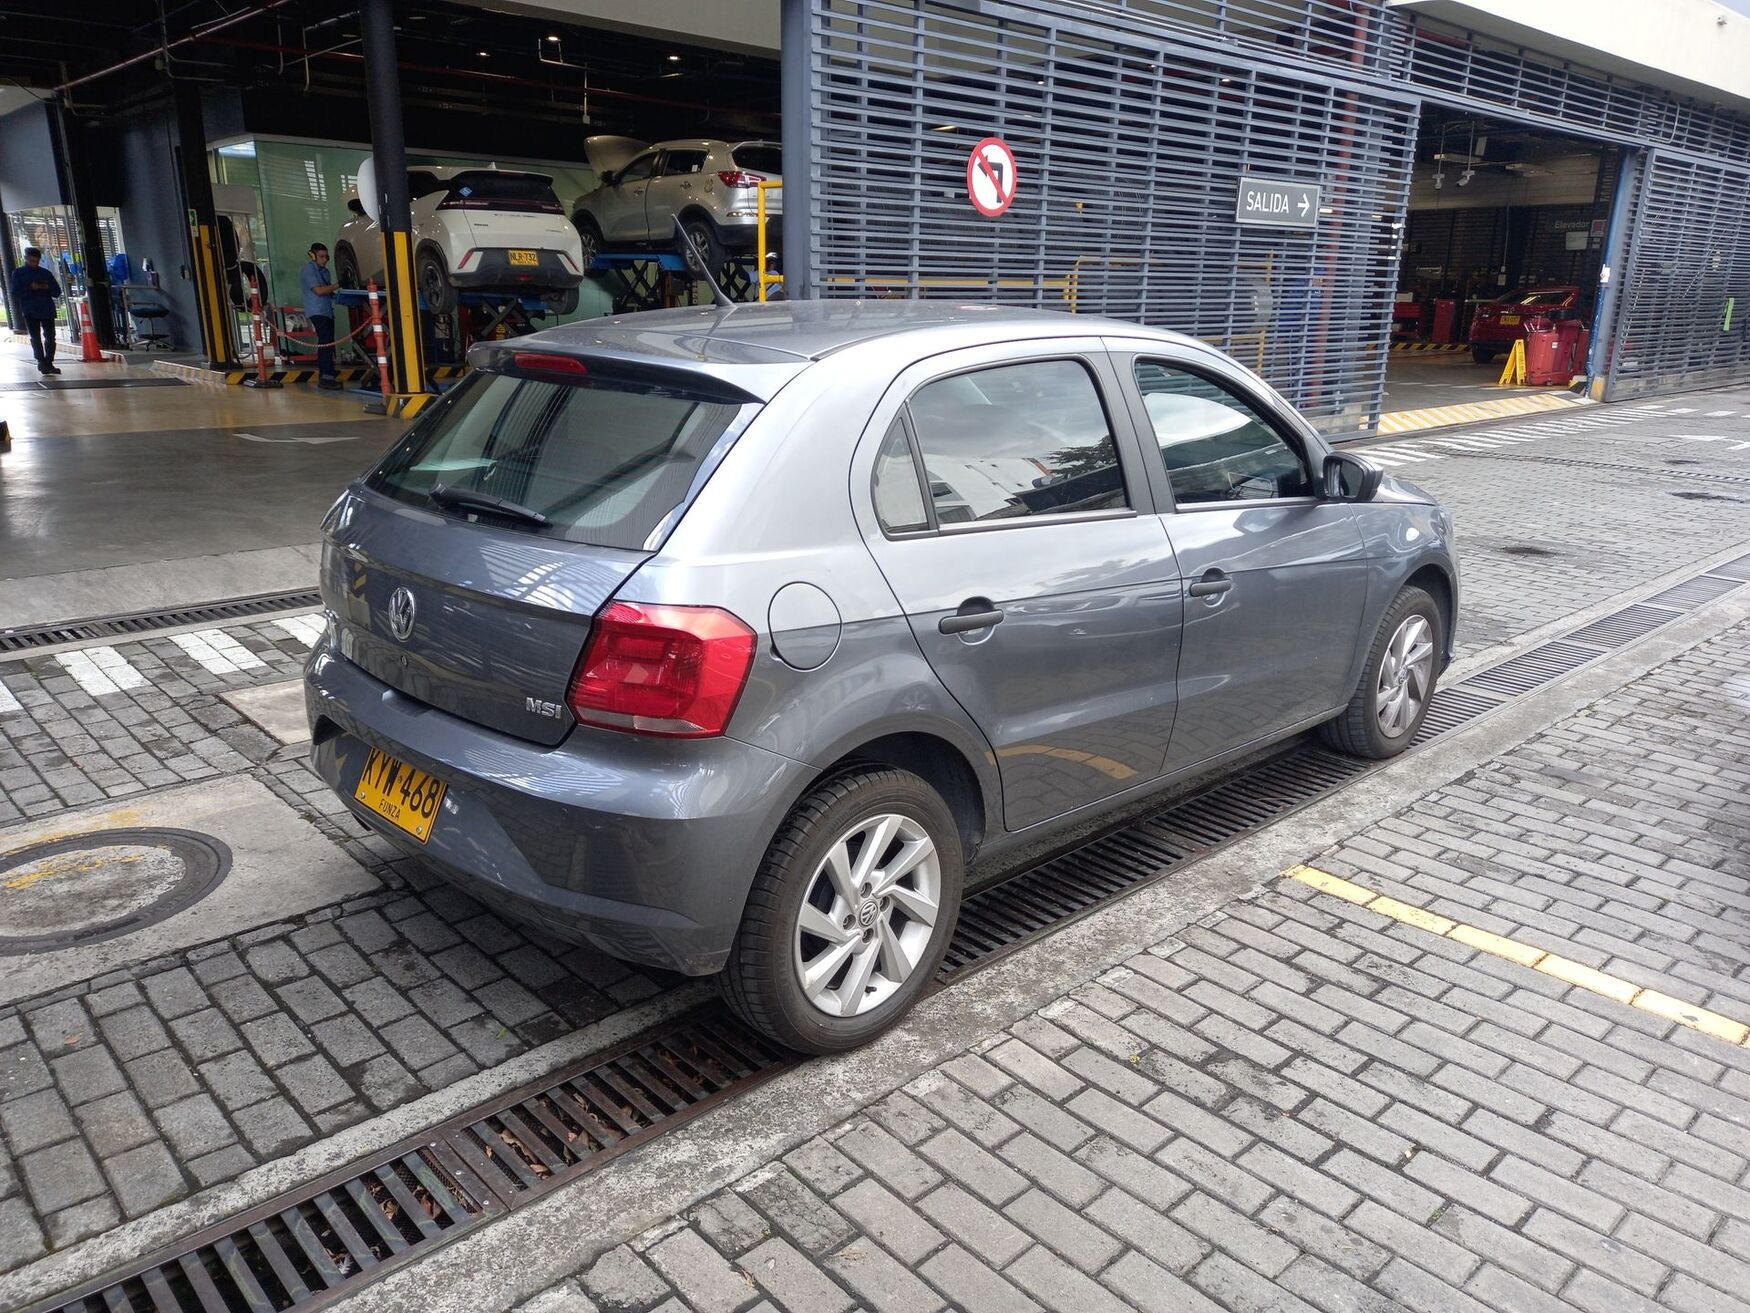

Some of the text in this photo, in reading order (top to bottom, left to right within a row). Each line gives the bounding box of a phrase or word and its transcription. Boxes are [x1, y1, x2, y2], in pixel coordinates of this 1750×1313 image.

[1246, 190, 1289, 214] SALIDA
[526, 696, 562, 719] MSI
[379, 798, 402, 820] FUNZA
